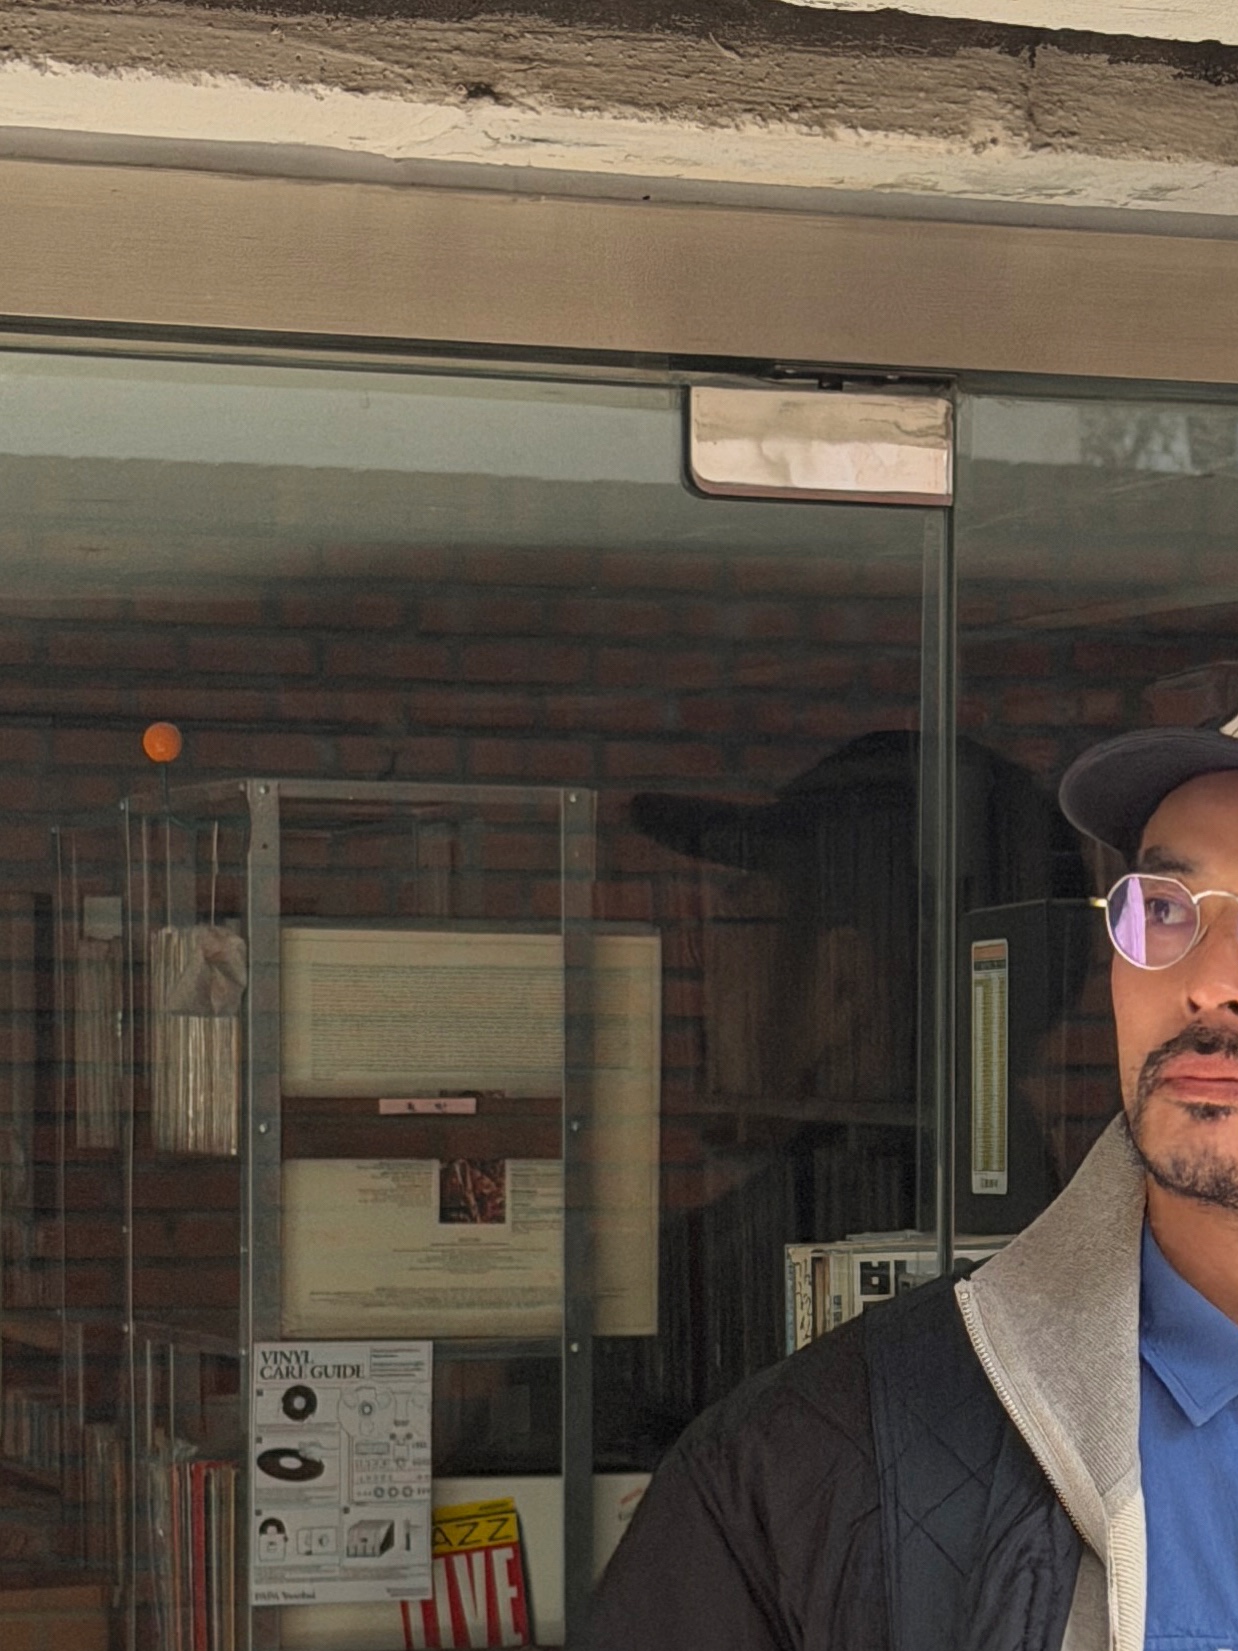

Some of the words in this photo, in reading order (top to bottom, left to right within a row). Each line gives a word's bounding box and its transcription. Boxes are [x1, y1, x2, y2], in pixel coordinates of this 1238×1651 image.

[260, 1350, 313, 1365] VINYL
[432, 1517, 514, 1548] AZZ
[408, 1546, 523, 1650] IVE
